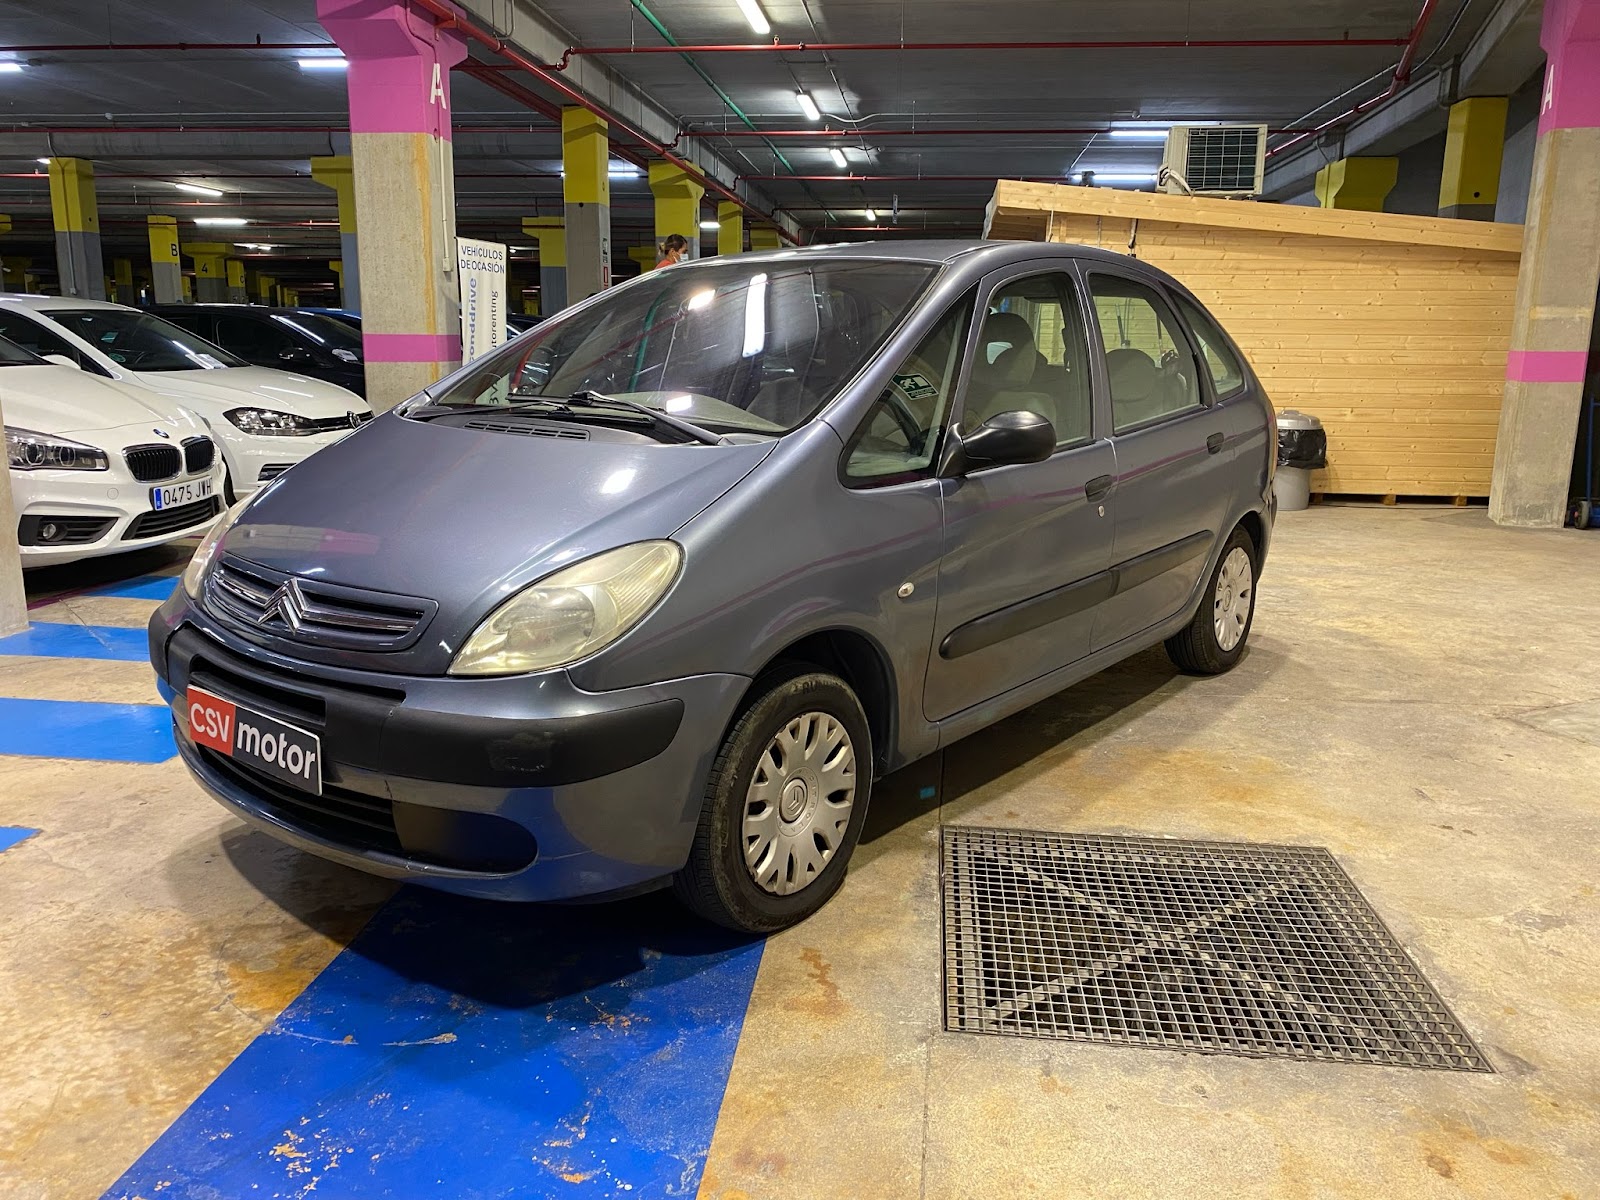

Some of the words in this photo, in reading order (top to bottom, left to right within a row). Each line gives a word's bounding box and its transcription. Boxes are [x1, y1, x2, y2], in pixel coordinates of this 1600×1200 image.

[430, 63, 447, 110] A
[1541, 64, 1555, 116] A
[171, 243, 178, 257] B
[461, 244, 503, 261] VEHÍCULOS
[201, 263, 208, 273] 4
[163, 484, 192, 506] 0475
[190, 702, 230, 743] CSV
[236, 722, 316, 779] motor
